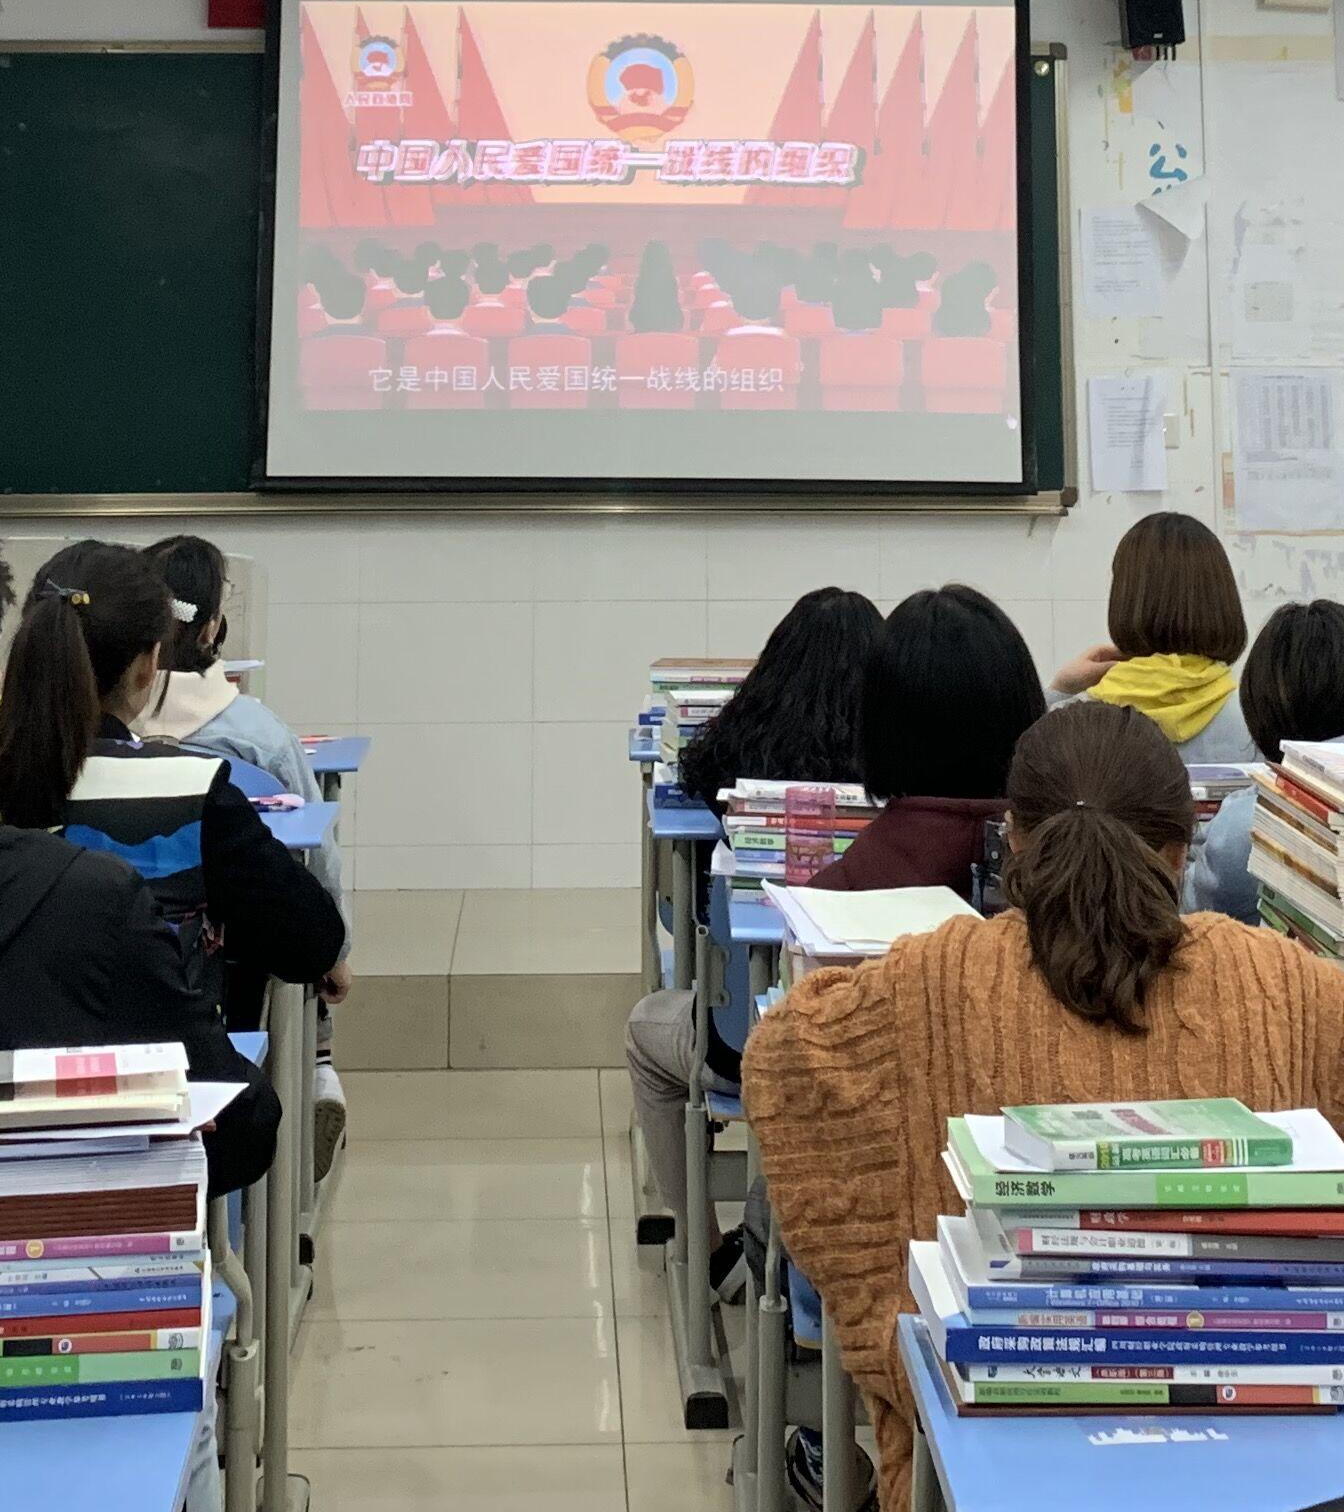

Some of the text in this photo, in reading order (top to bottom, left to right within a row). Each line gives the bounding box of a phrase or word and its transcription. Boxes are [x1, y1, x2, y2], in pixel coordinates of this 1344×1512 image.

[356, 138, 860, 185] 中国人民爱国统一战线的组织
[368, 365, 784, 393] 它是中国人民爱国统一战线的组织
[994, 1180, 1056, 1198] 经济数学
